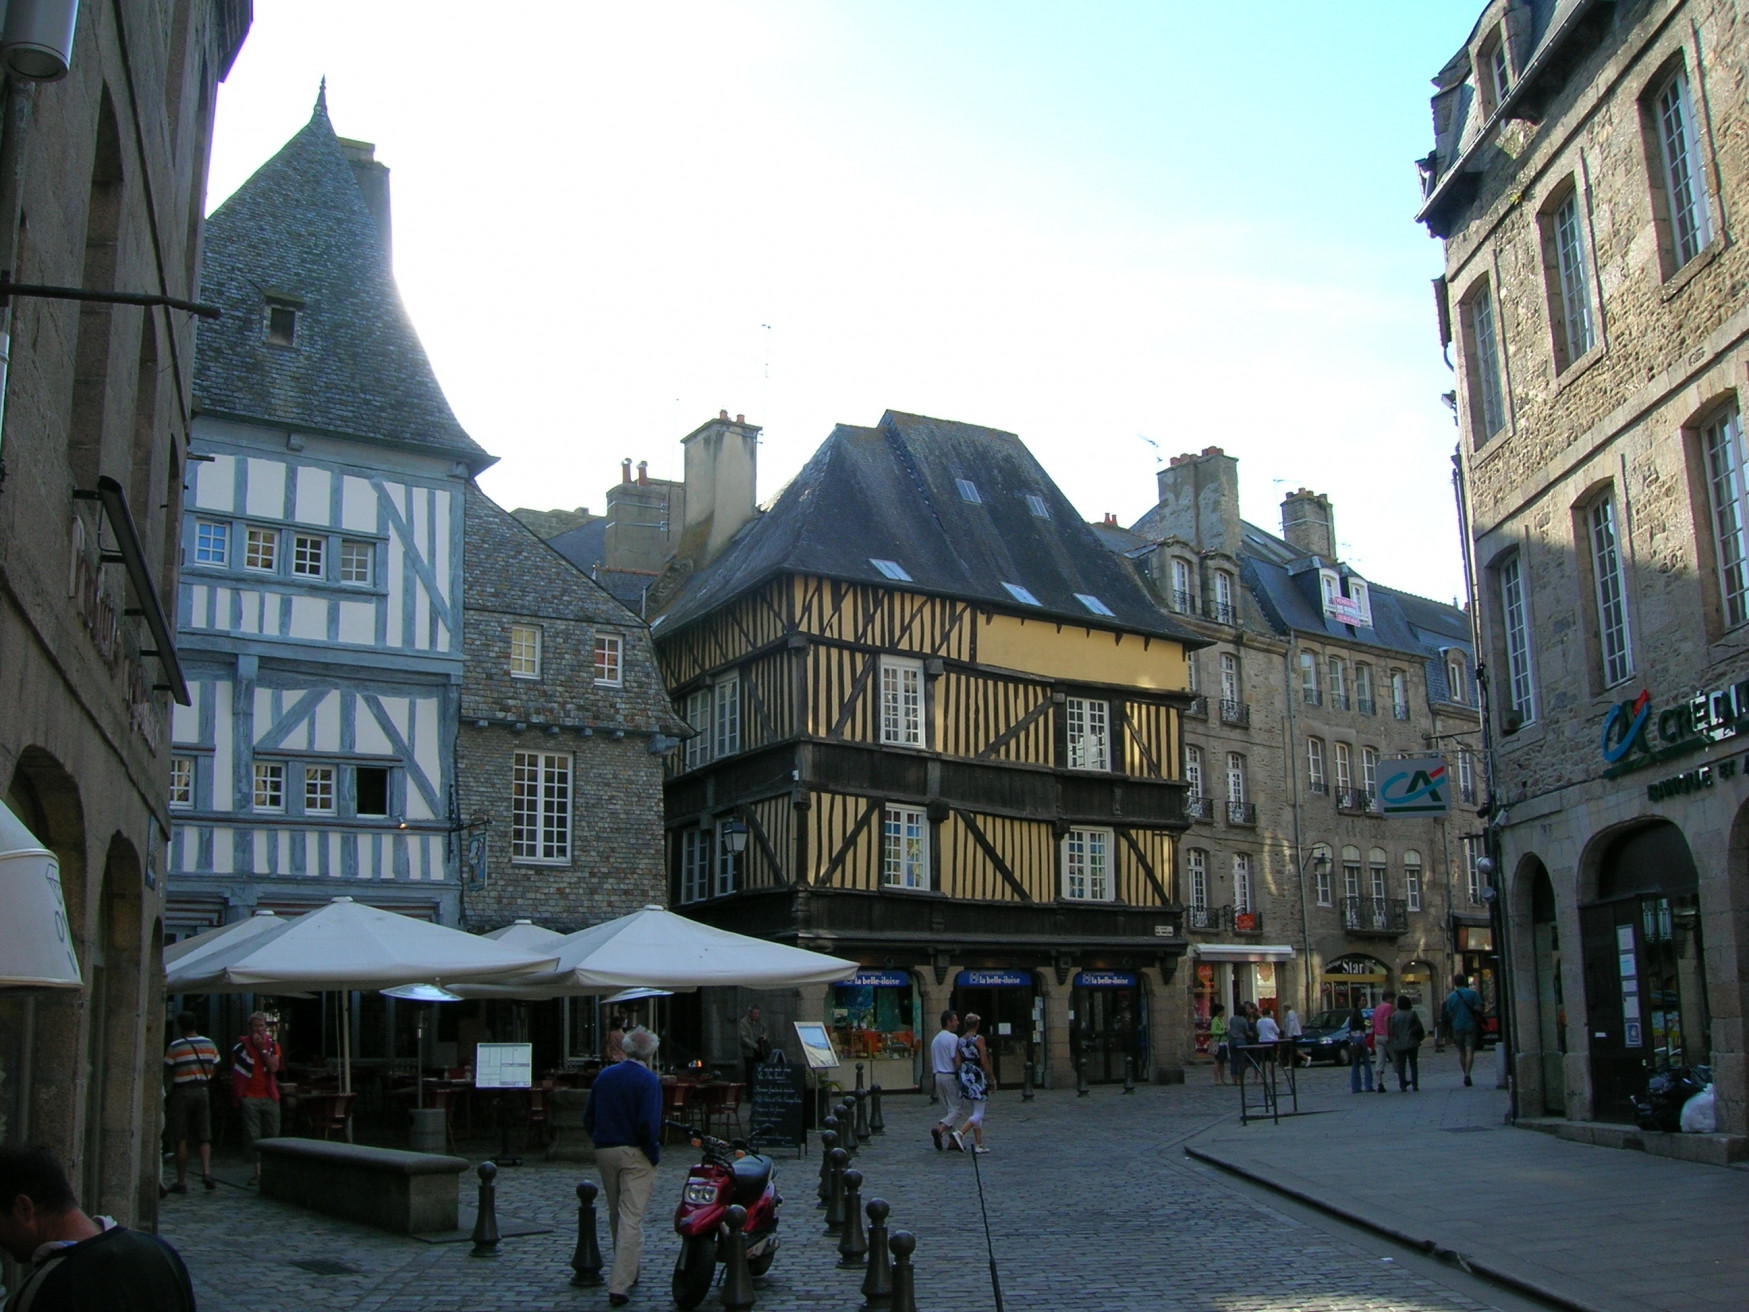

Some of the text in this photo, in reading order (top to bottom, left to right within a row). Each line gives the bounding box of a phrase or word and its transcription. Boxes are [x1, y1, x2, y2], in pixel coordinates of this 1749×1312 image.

[1647, 766, 1713, 802] BANQUE
[1342, 959, 1364, 975] Star
[855, 976, 862, 985] la
[979, 976, 986, 984] la
